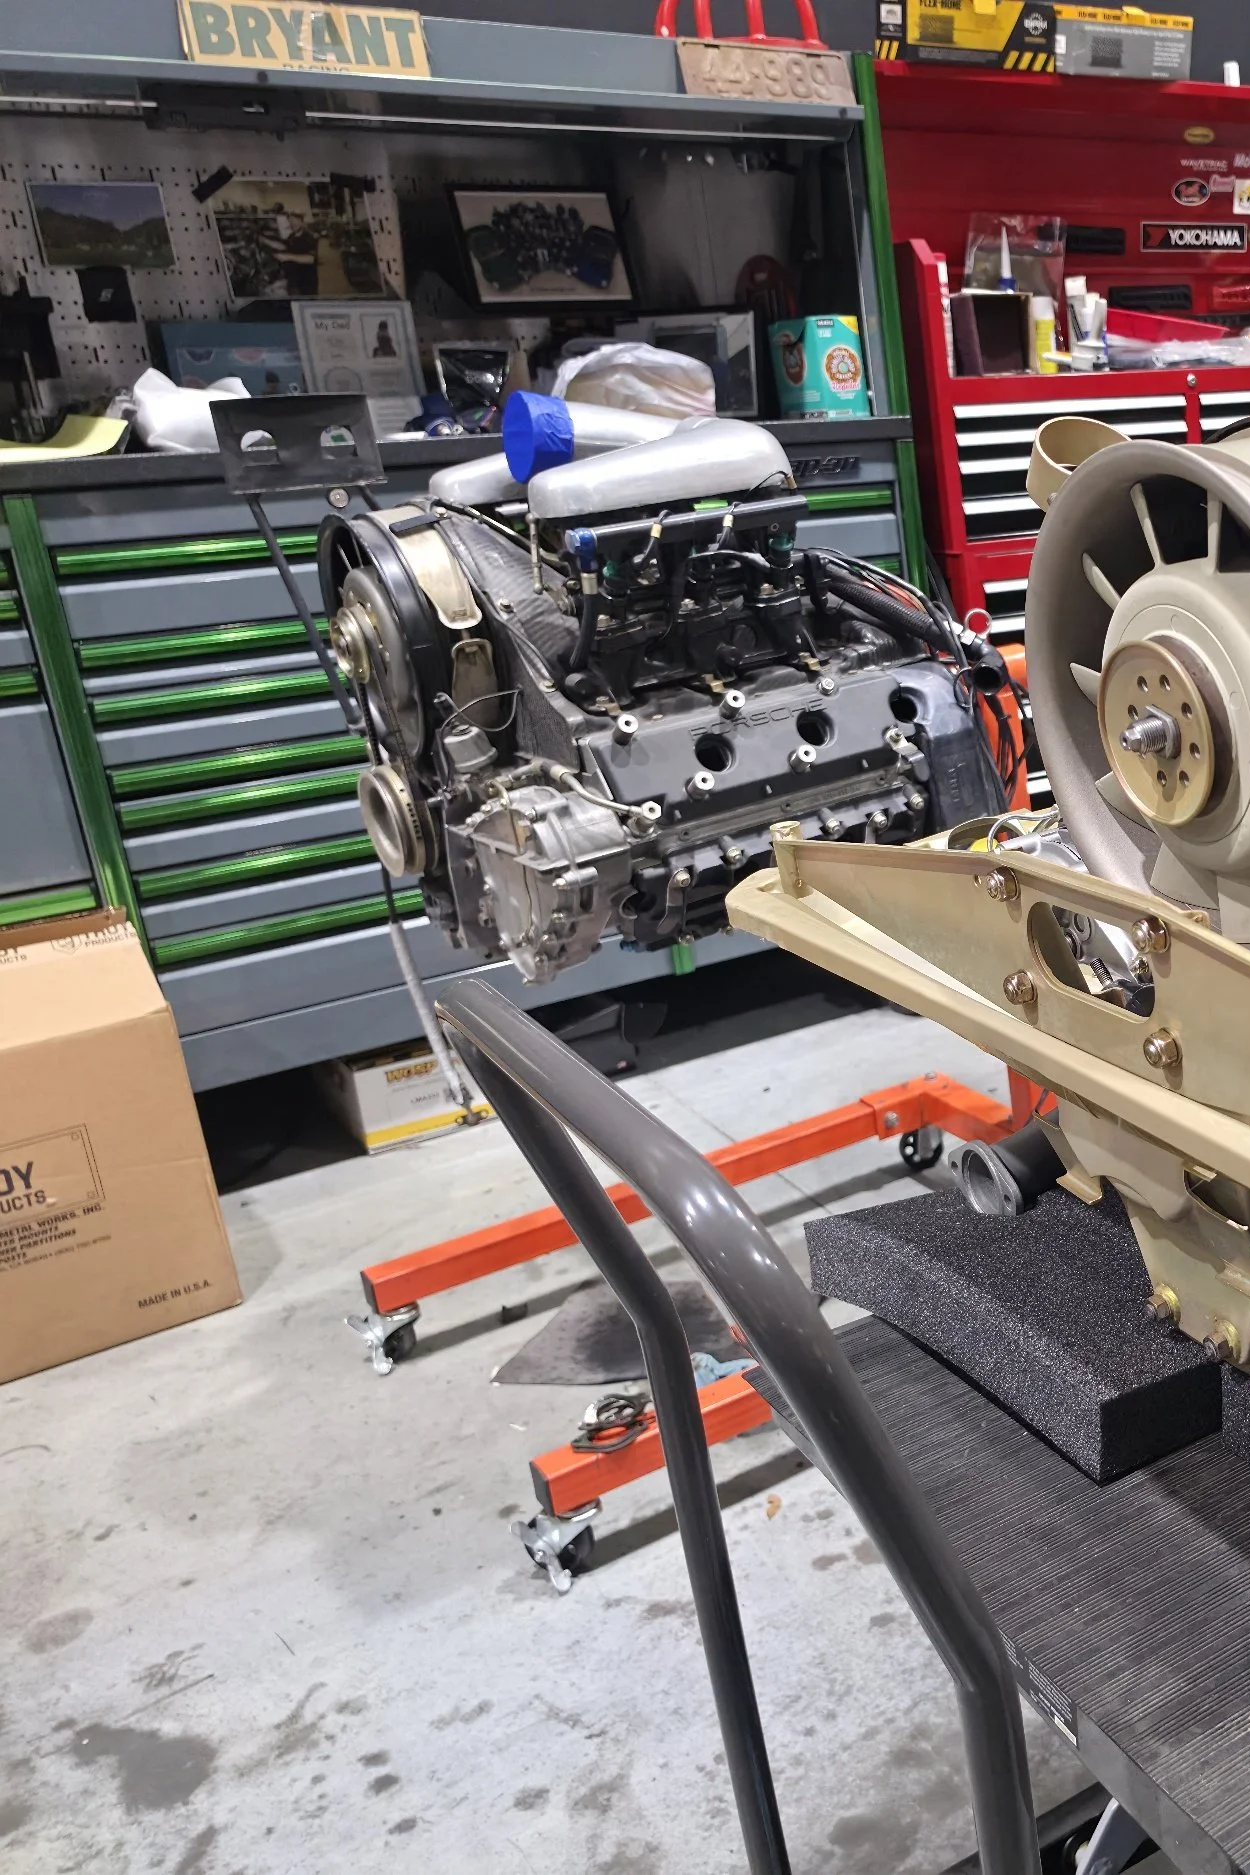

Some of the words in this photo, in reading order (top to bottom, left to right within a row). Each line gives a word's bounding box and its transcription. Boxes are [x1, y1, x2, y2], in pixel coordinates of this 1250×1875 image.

[190, 3, 416, 68] BRYANT
[1168, 229, 1242, 247] YOKOHAMA
[689, 698, 827, 741] PORSCHE
[20, 1228, 77, 1250] PARTITIONS
[138, 1292, 169, 1309] MADE
[170, 1288, 182, 1298] IN
[183, 1280, 213, 1295] U.S.A.
